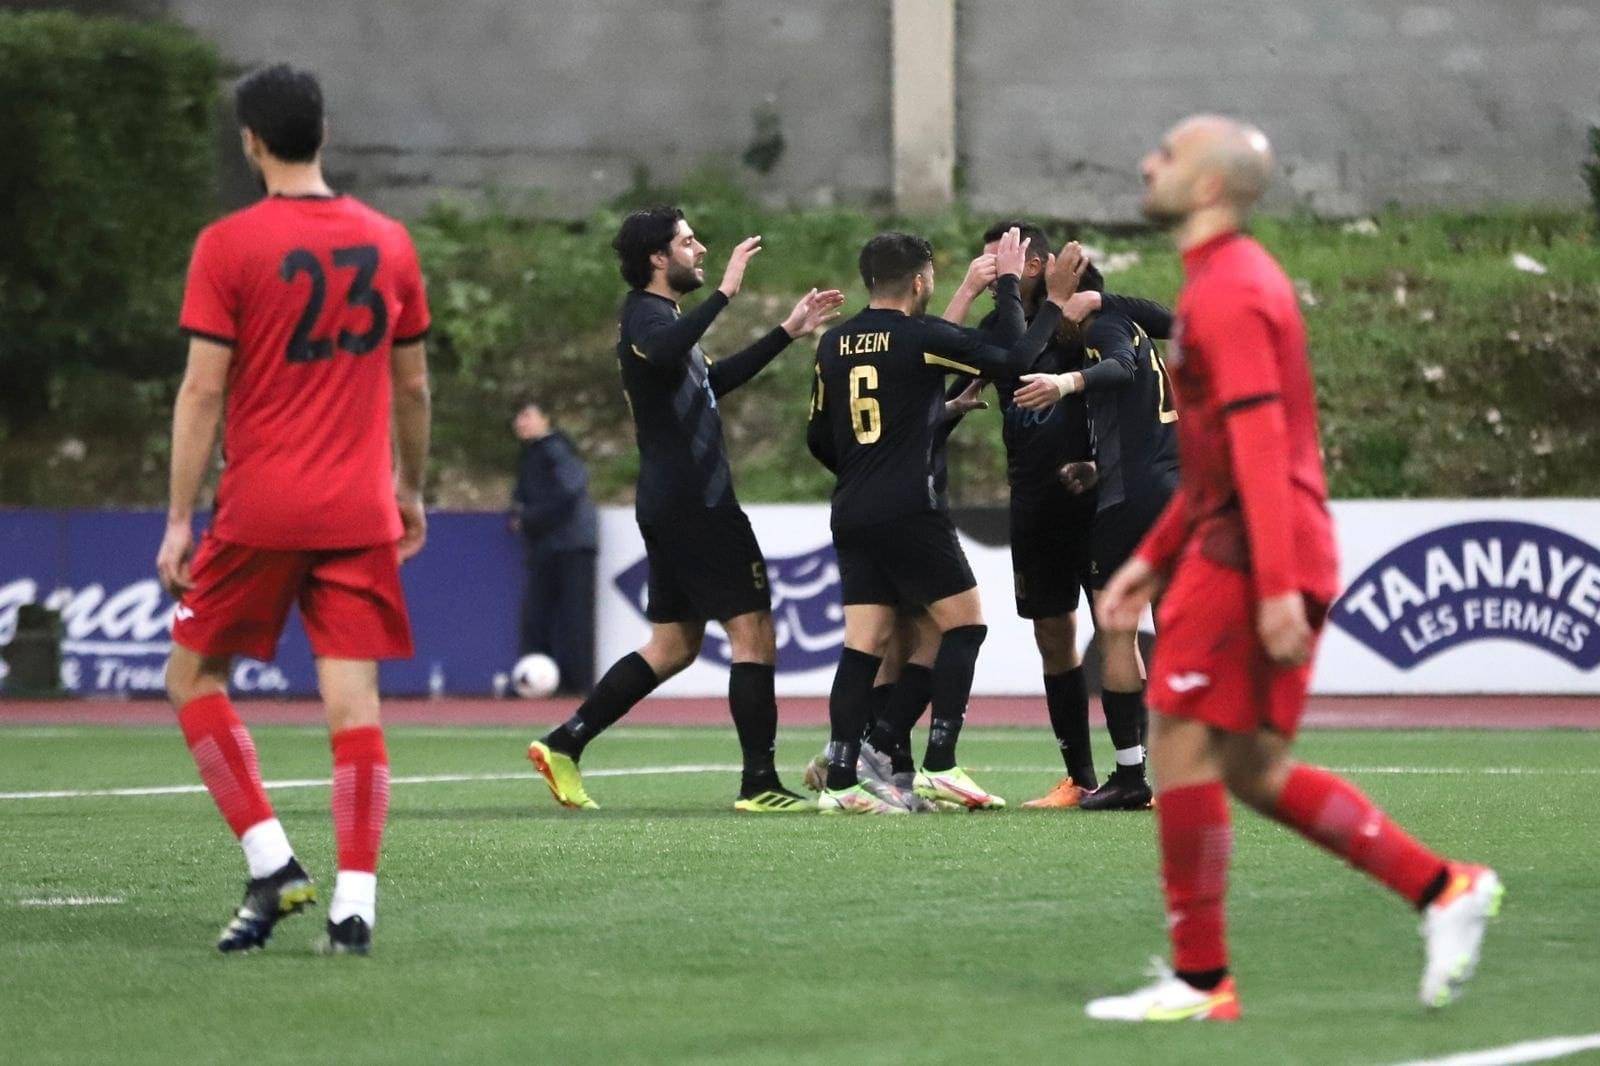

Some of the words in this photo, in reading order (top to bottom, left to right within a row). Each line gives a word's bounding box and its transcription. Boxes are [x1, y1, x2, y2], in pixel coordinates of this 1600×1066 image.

[279, 244, 389, 363] 23
[849, 364, 882, 445] 6
[751, 561, 766, 590] 5
[1345, 537, 1600, 633] TAANAYE
[1400, 604, 1459, 654] LES
[1463, 598, 1590, 653] FERMES
